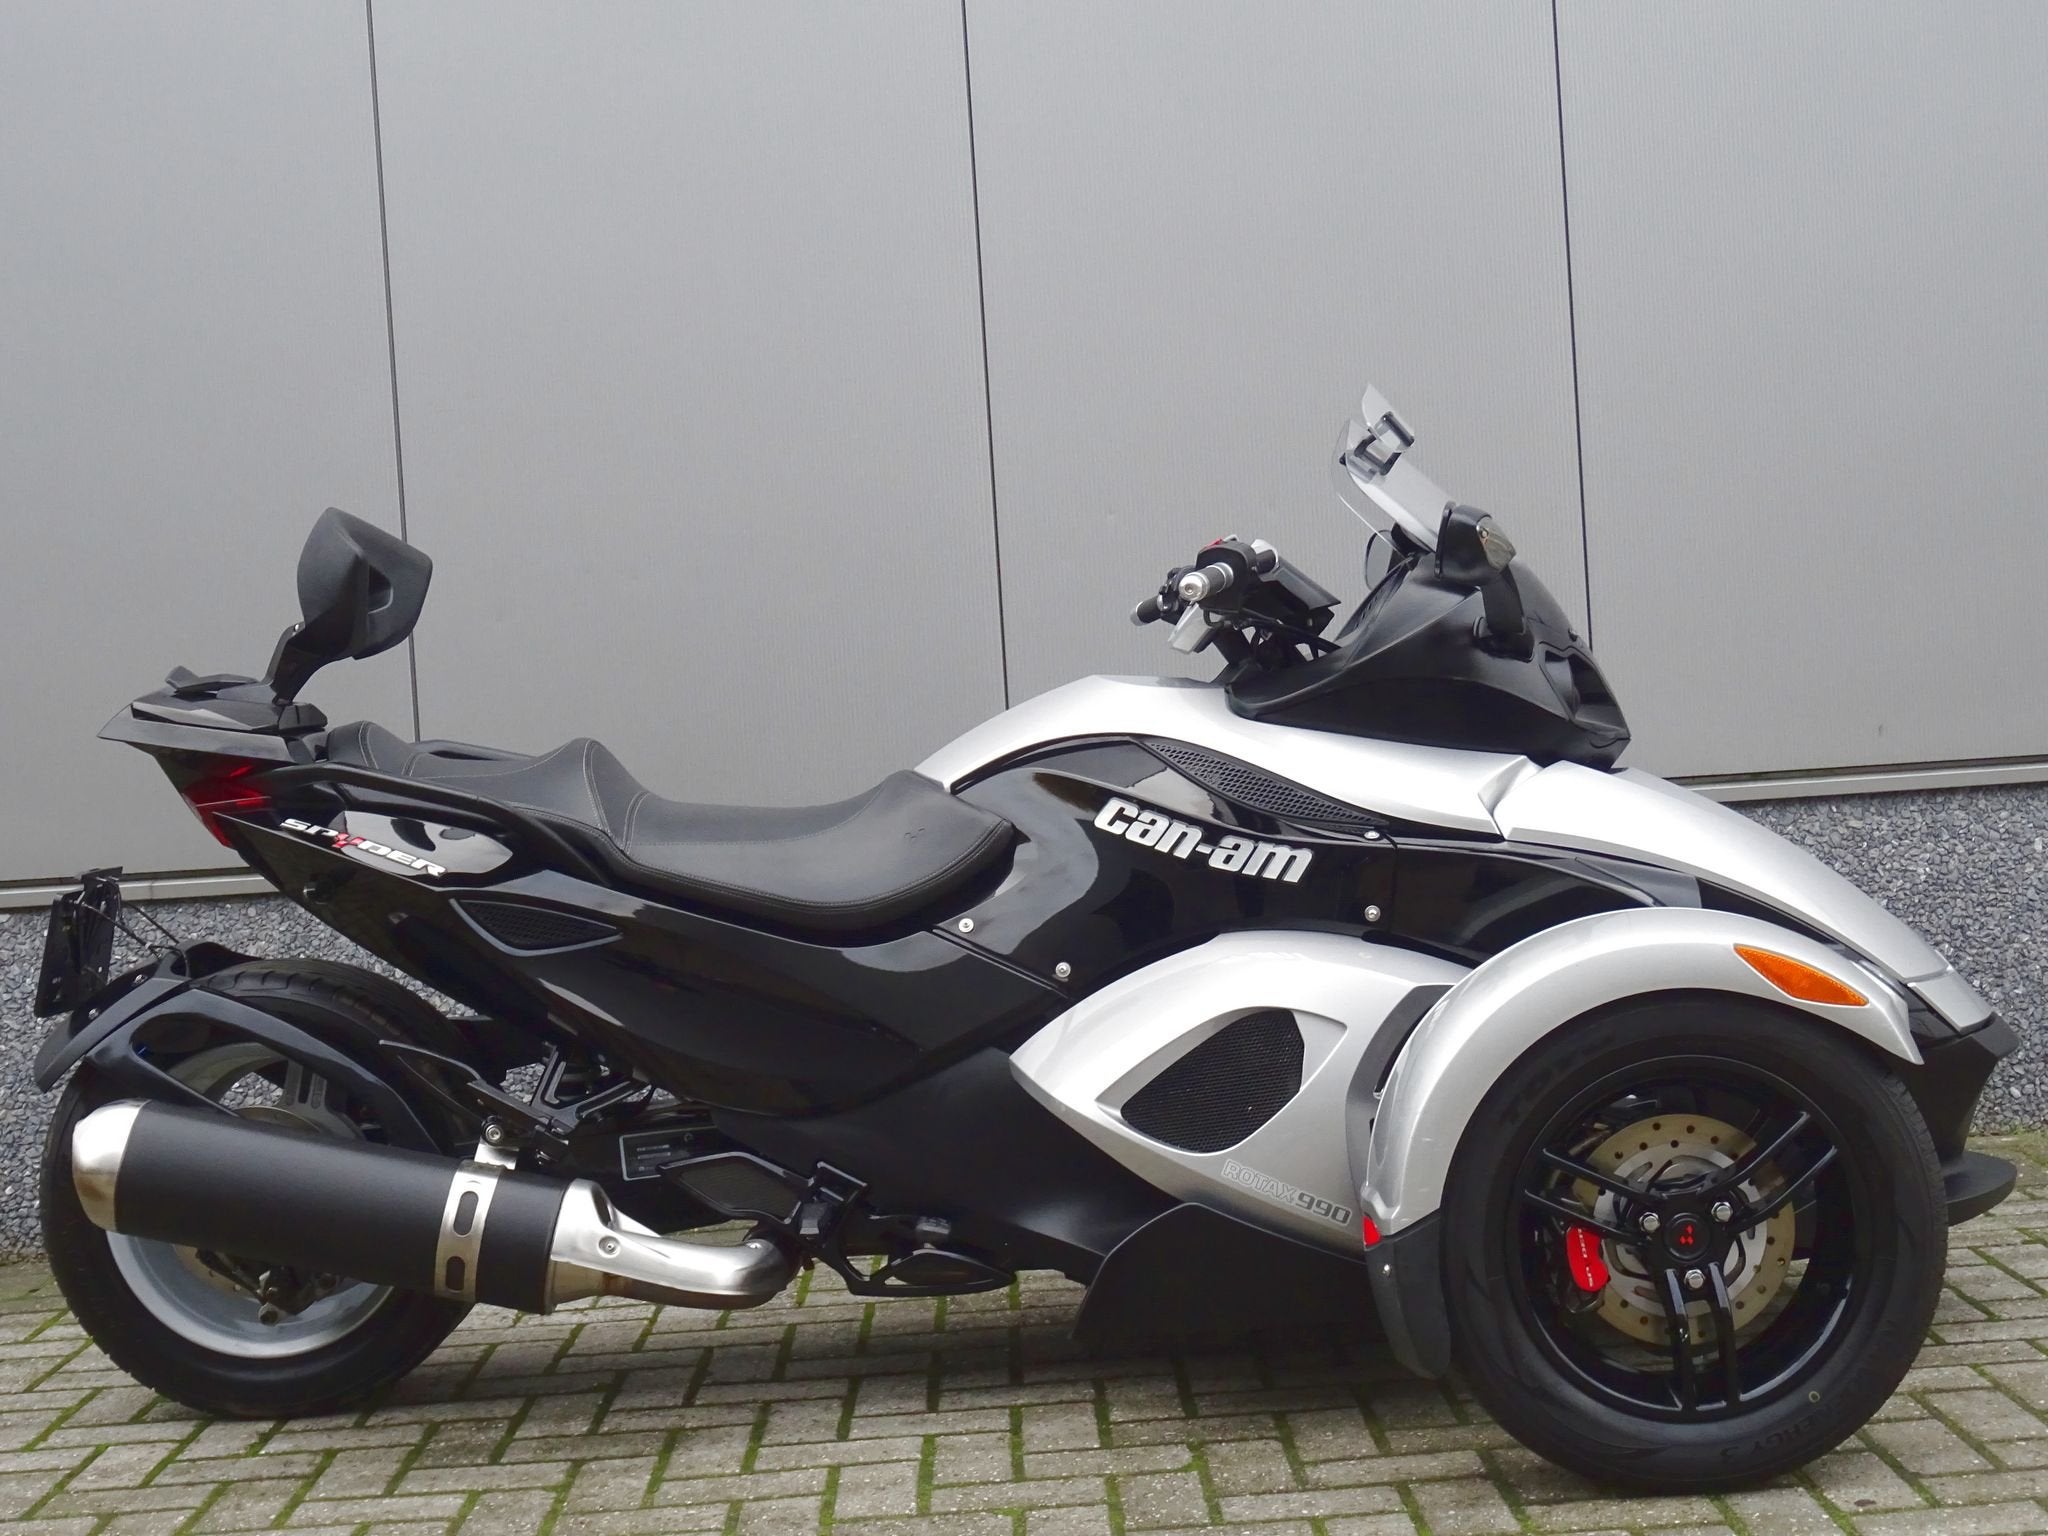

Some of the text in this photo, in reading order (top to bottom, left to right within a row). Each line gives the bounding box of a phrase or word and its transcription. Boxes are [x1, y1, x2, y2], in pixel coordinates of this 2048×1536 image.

[1094, 796, 1313, 883] can-am
[1222, 1159, 1352, 1225] ROTAX 990
